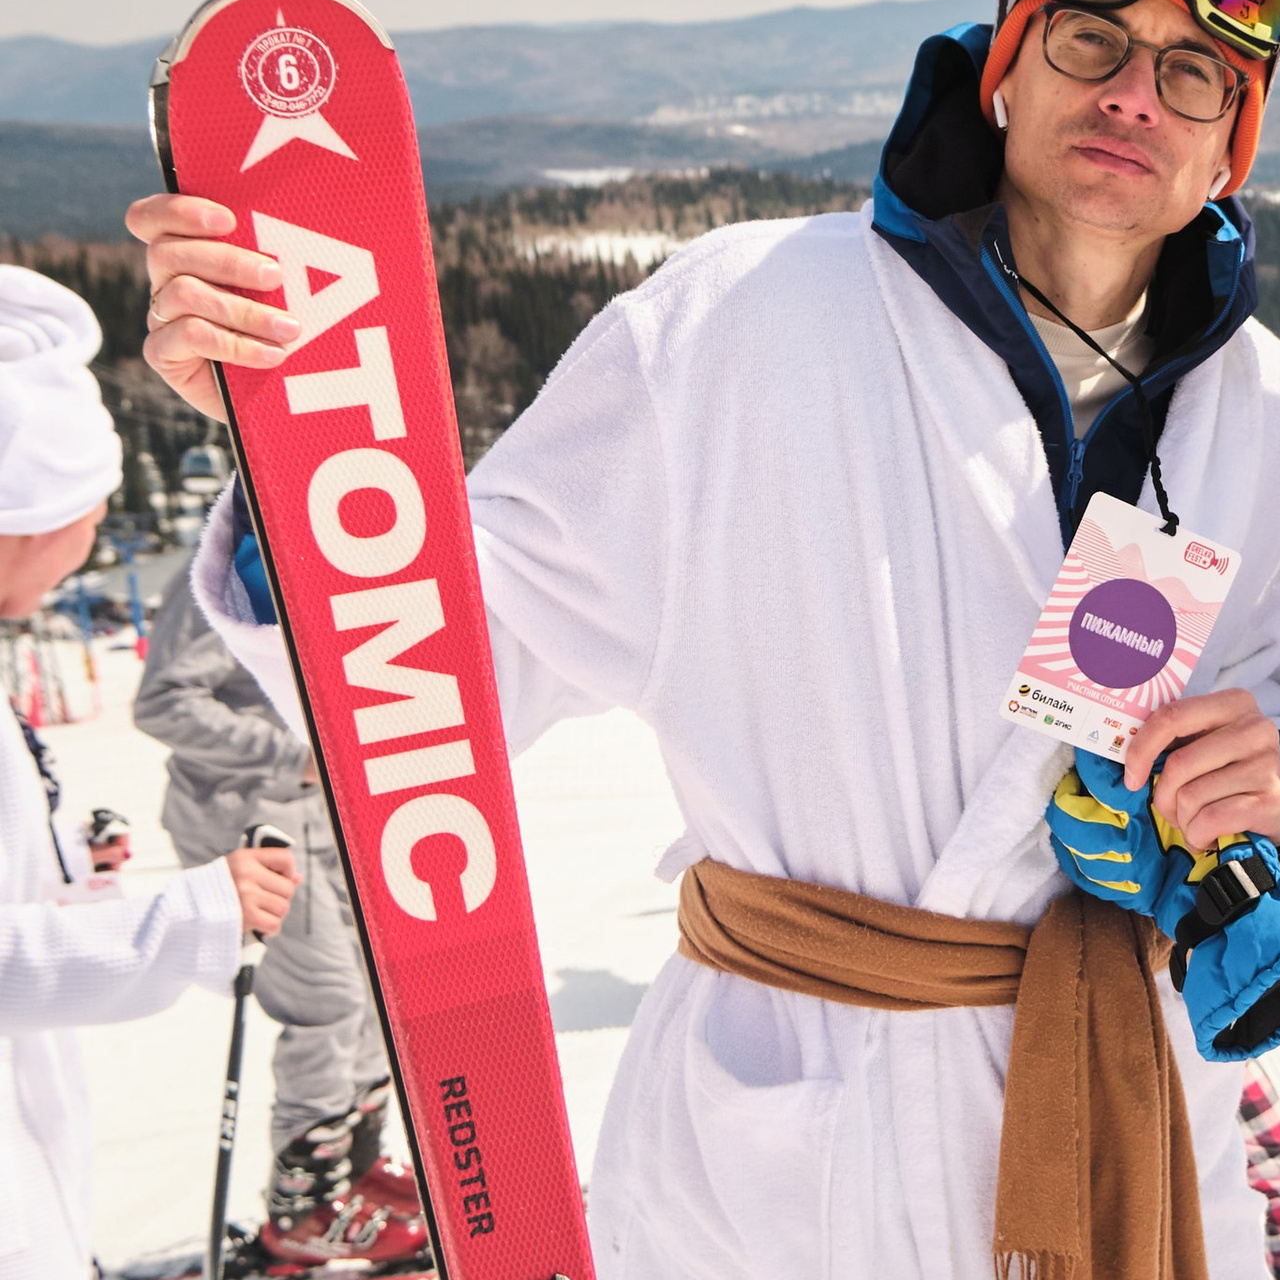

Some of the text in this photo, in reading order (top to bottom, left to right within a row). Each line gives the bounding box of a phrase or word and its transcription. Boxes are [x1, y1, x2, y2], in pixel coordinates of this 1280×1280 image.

[256, 32, 291, 53] ПРОКАТ
[278, 53, 300, 91] 6
[251, 210, 497, 921] ATOMIC
[1187, 552, 1203, 564] FEST
[1081, 612, 1164, 659] ПИЖАМНЫЙ
[1032, 689, 1074, 714] билайн
[439, 1075, 496, 1239] REDSTER
